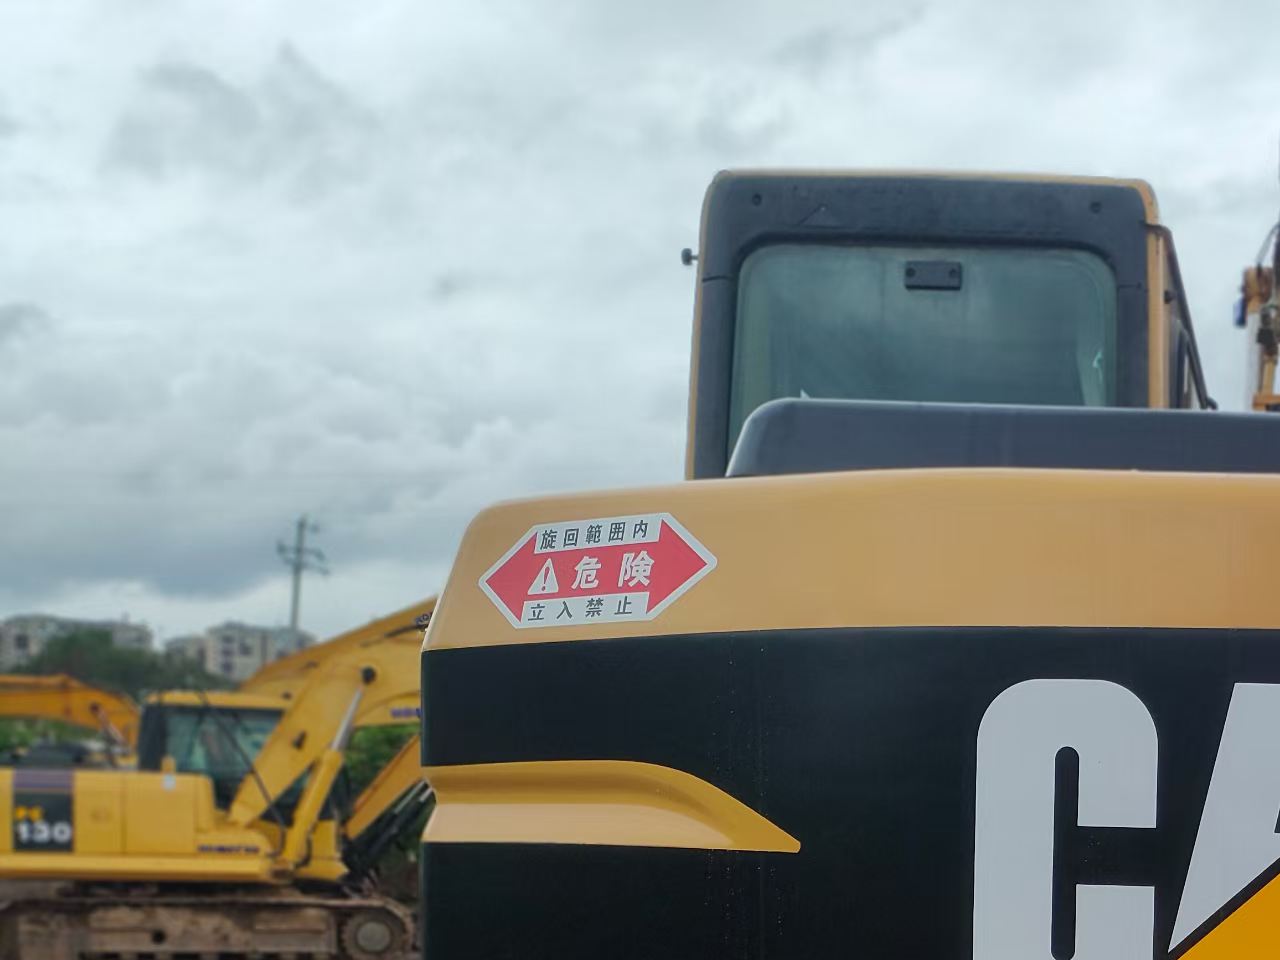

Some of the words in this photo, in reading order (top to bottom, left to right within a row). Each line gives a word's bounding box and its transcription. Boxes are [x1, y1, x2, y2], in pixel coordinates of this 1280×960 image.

[539, 520, 649, 550] 旋回範囲内
[571, 550, 655, 590] 危険
[527, 596, 633, 622] 立入禁止
